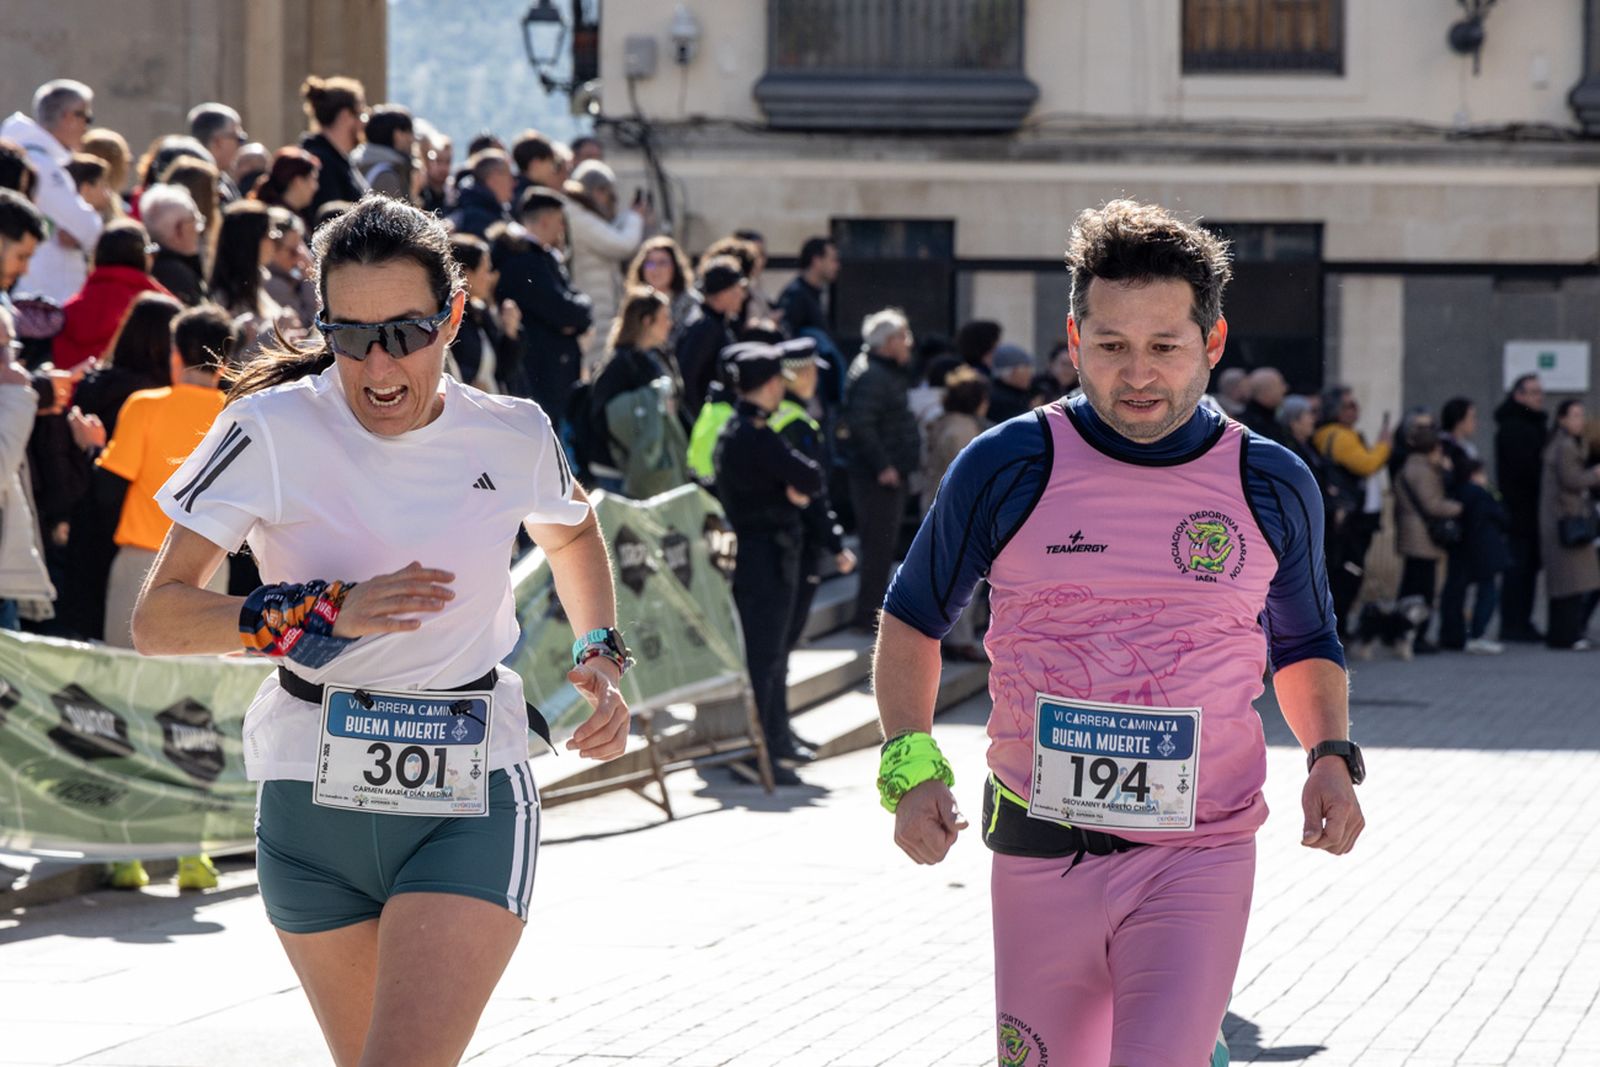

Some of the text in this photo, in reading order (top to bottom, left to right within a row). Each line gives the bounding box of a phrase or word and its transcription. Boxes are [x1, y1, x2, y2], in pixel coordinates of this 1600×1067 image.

[1189, 510, 1239, 533] DEPORTIVA
[1046, 544, 1109, 554] TEAMERGY
[418, 704, 471, 717] CAMIN
[1053, 710, 1178, 732] VI CARRERA CAMINATA
[345, 715, 447, 740] BUENA MUERTE
[1052, 727, 1151, 754] BUENA MUERTE
[363, 742, 447, 789] 301
[1070, 755, 1150, 802] 194
[352, 785, 384, 794] CARMEN
[426, 790, 453, 798] MEDINA
[1062, 797, 1101, 808] GEOVANNY
[1102, 802, 1132, 811] BARRETO
[1001, 1012, 1032, 1035] ORTIVA
